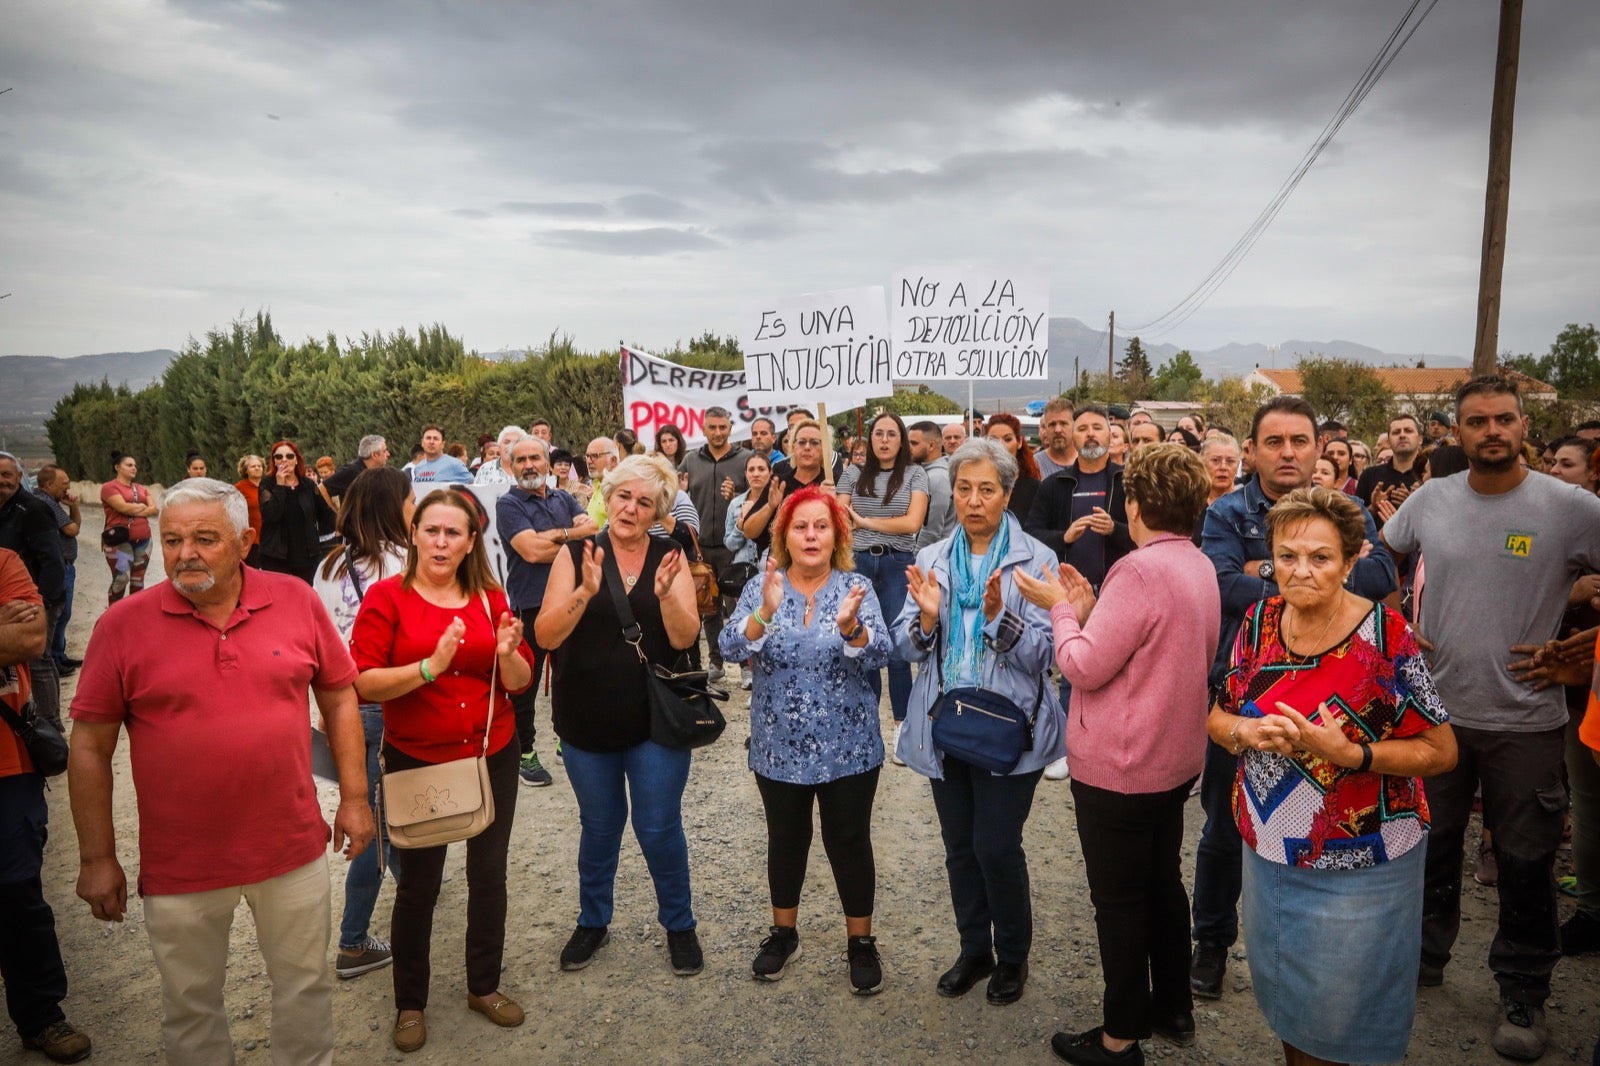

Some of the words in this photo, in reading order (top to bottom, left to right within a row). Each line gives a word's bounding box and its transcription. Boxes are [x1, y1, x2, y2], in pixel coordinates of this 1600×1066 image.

[901, 276, 940, 307] NO
[948, 282, 967, 307] A
[982, 279, 1015, 307] LA
[800, 304, 854, 336] UNA
[896, 350, 947, 377] OTRA
